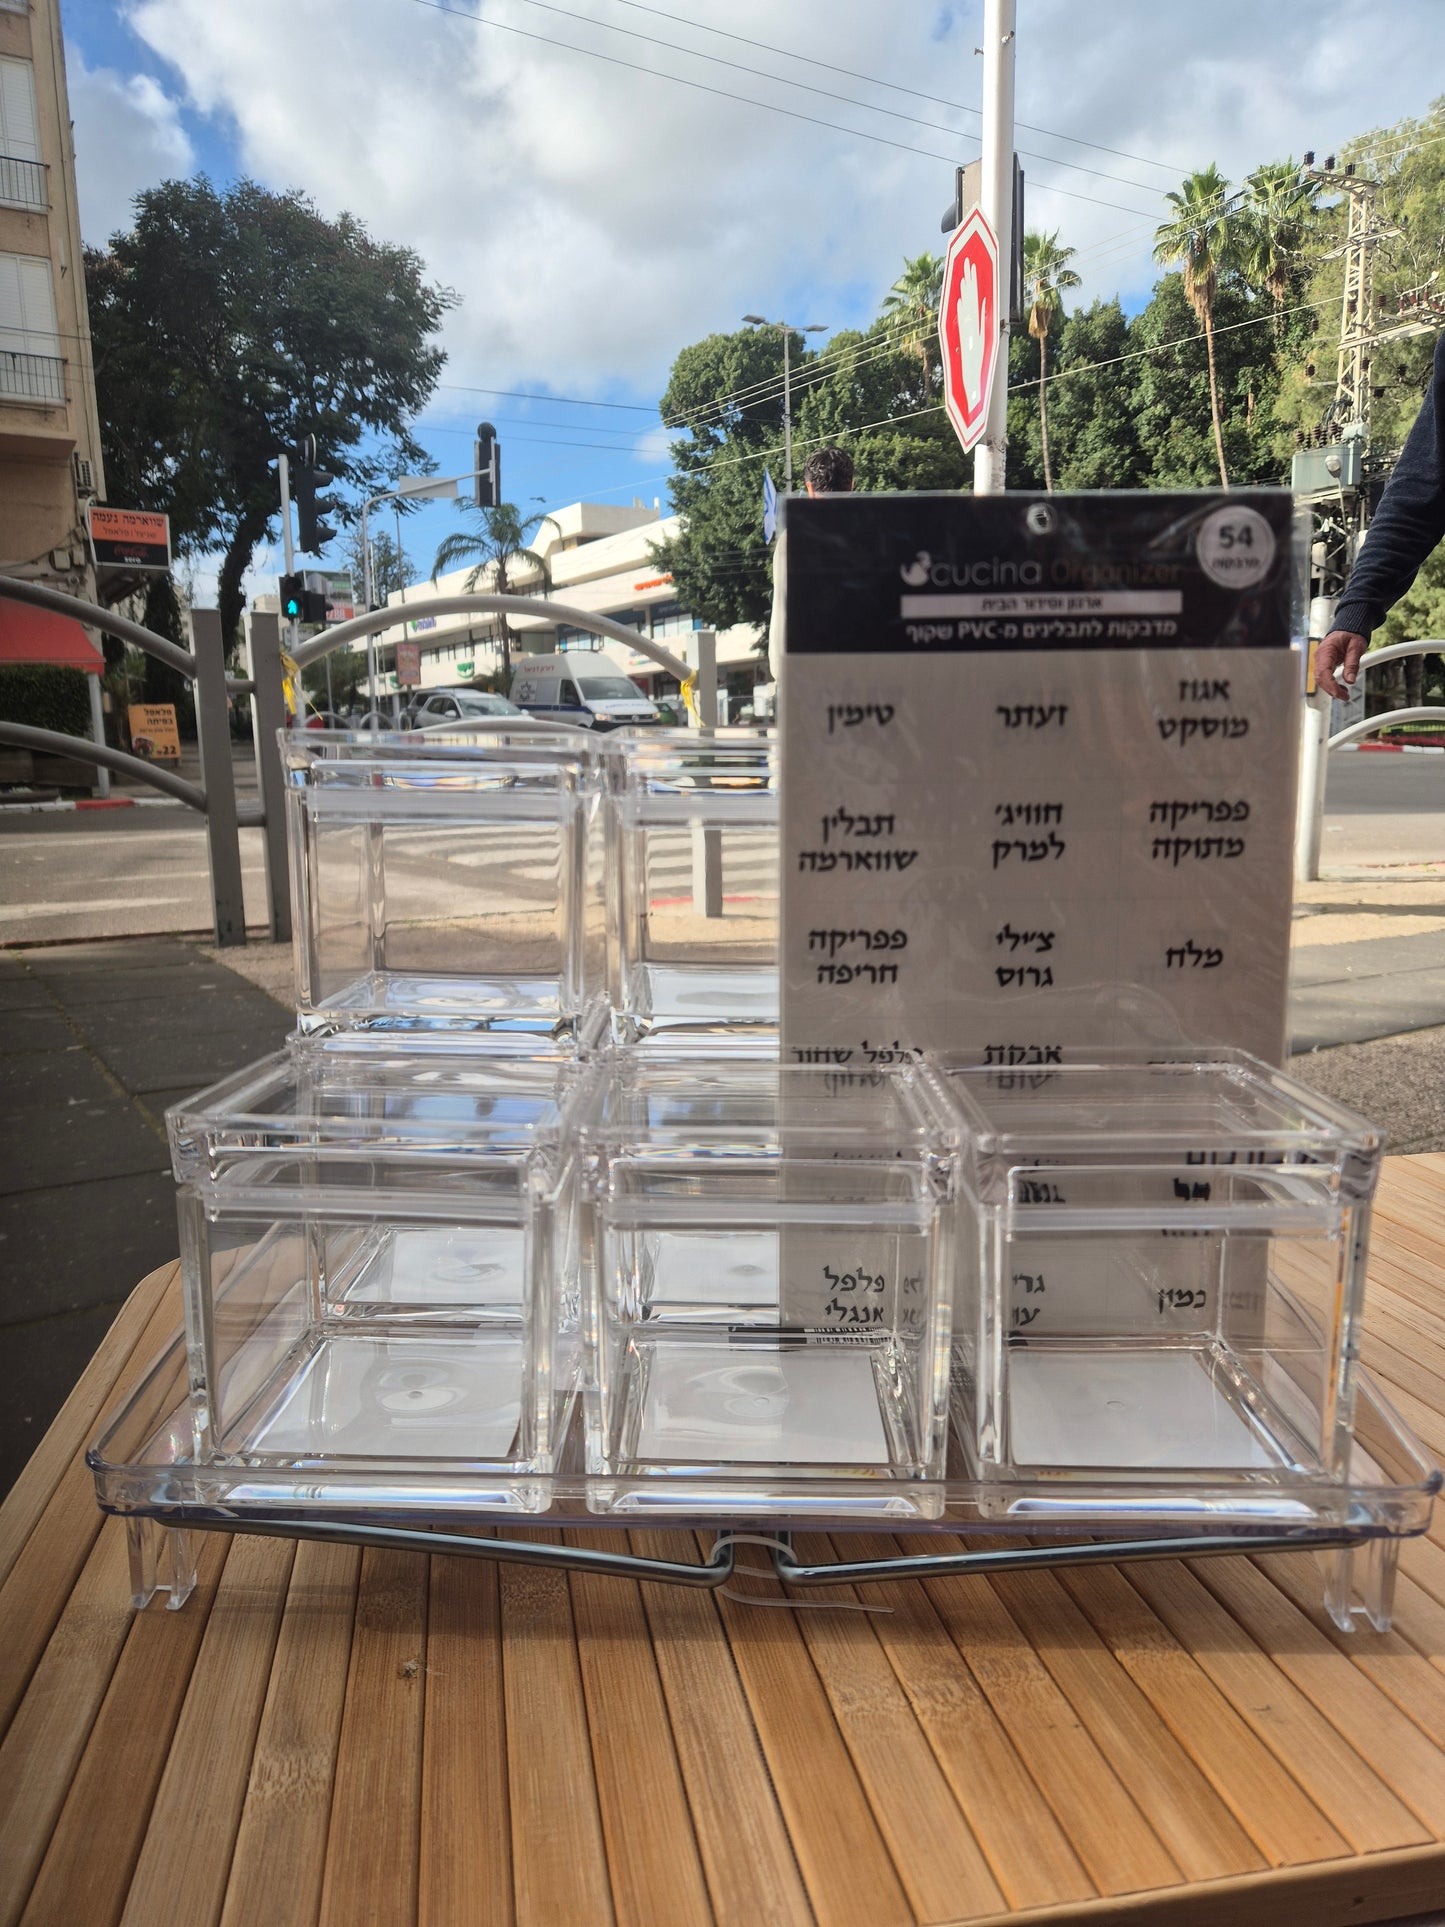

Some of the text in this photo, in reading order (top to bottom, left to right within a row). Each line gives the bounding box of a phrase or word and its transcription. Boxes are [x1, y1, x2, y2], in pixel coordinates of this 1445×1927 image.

[1219, 525, 1253, 549] 54
[930, 556, 1181, 589] cucina Organizer
[906, 623, 953, 644] שקוף
[1022, 619, 1104, 639] לתבלינים
[1105, 619, 1178, 640] מדבקות
[1179, 679, 1230, 703] אגוז
[827, 705, 895, 733] טימין
[997, 705, 1068, 729] זעתר
[1158, 718, 1249, 746] מוסקט
[163, 745, 177, 755] 22
[821, 809, 895, 842] תבלין
[1149, 800, 1250, 829] פפריקה
[798, 850, 919, 872] שווארמה
[991, 832, 1066, 871] למרק
[1152, 836, 1245, 866] מתוקה
[808, 929, 908, 954] פפריקה
[1166, 938, 1223, 970] מלח
[816, 964, 898, 986] חריפה
[996, 965, 1054, 989] גרוס
[791, 1046, 855, 1064] שחור
[983, 1043, 1063, 1066] אבקת
[822, 1265, 885, 1293] פלפל
[825, 1297, 885, 1325] אנגלי
[1157, 1288, 1207, 1310] כמון
